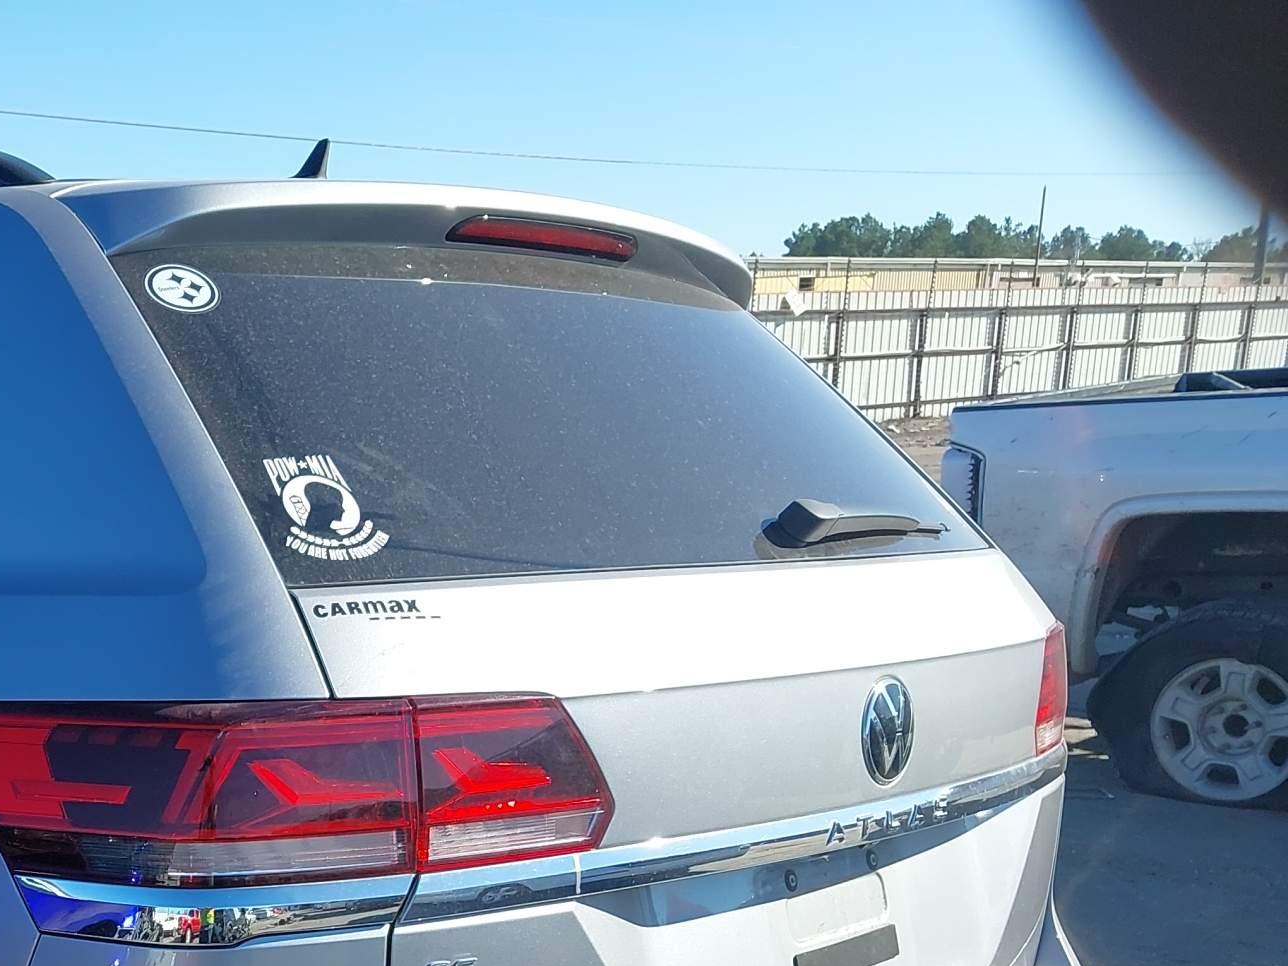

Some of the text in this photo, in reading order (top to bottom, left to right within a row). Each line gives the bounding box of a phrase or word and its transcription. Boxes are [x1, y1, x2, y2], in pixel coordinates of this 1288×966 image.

[263, 454, 353, 496] POW MIA
[285, 534, 309, 554] YOU
[307, 544, 328, 560] ARE
[328, 548, 350, 561] NOT
[826, 789, 950, 846] ATLAS
